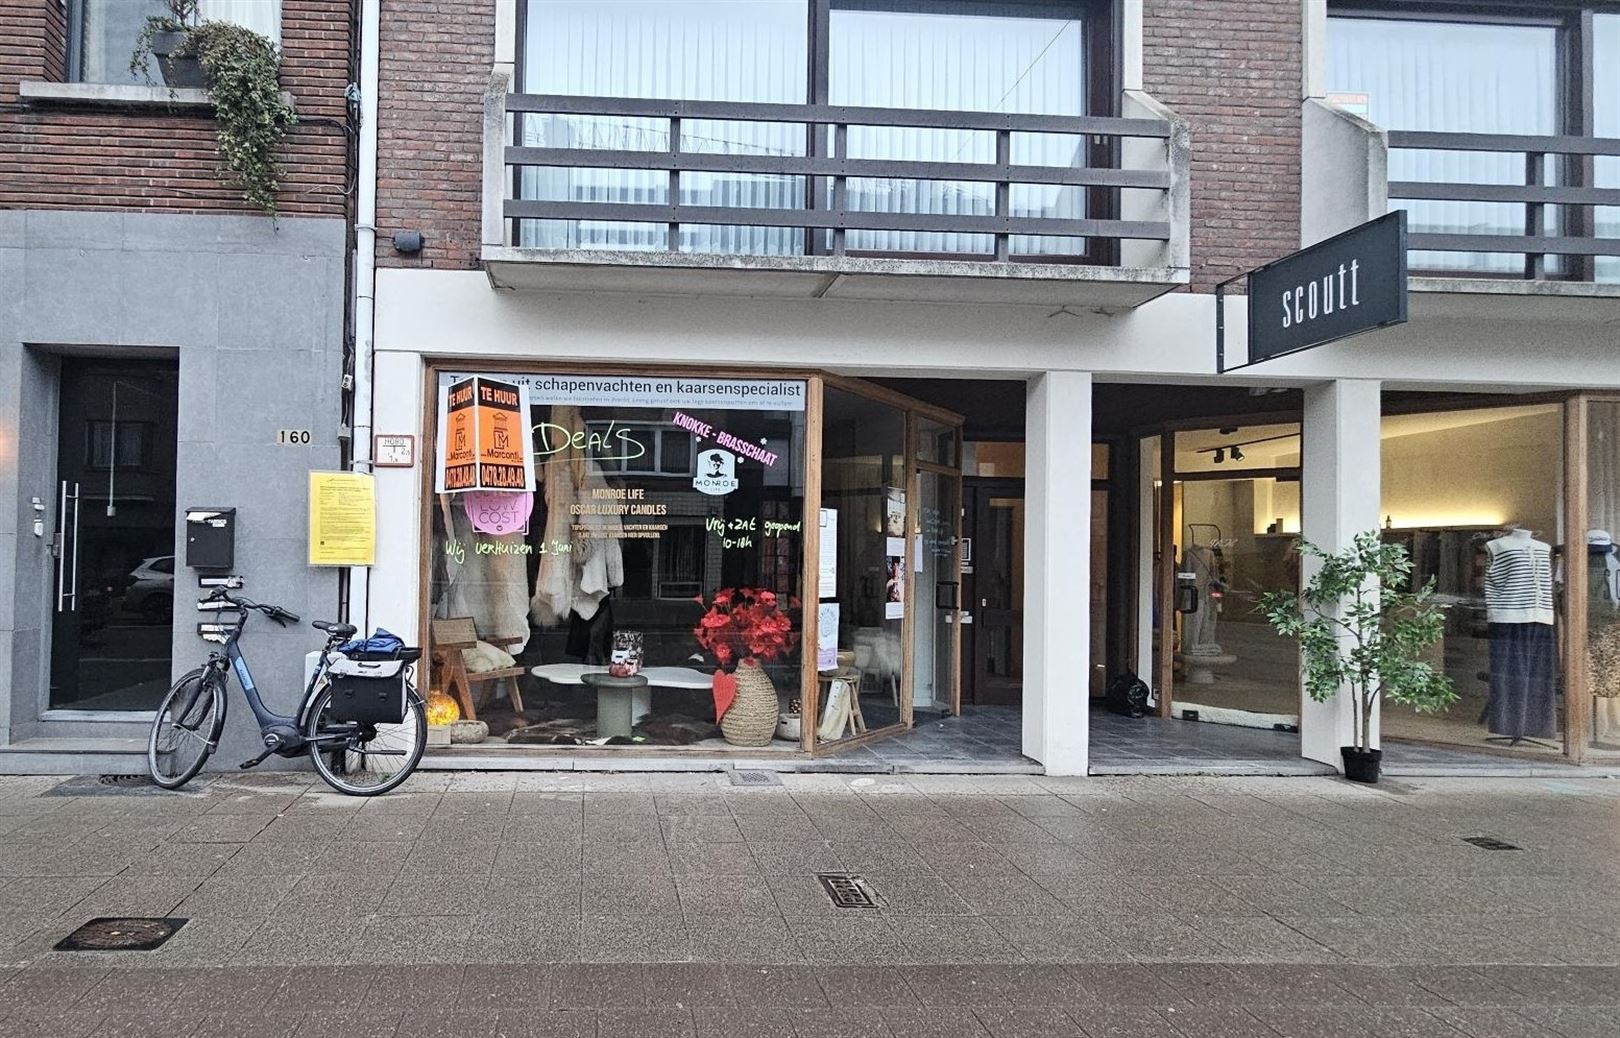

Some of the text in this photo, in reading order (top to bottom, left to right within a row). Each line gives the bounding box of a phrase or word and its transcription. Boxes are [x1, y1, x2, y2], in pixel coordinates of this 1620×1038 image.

[1282, 258, 1360, 328] scoutt
[448, 386, 473, 407] TE HUUR
[481, 386, 518, 406] TE HUUR
[535, 378, 652, 394] schapenvachten
[656, 383, 672, 393] en
[677, 381, 801, 397] kaarsenspecialist
[281, 430, 310, 444] 160
[673, 411, 712, 438] KNOKKE
[716, 431, 778, 467] BRASSCHAAT
[592, 488, 644, 500] MONROE LIFE
[478, 511, 519, 525] COST
[570, 504, 667, 515] OSCAR LUXURY CANDLES
